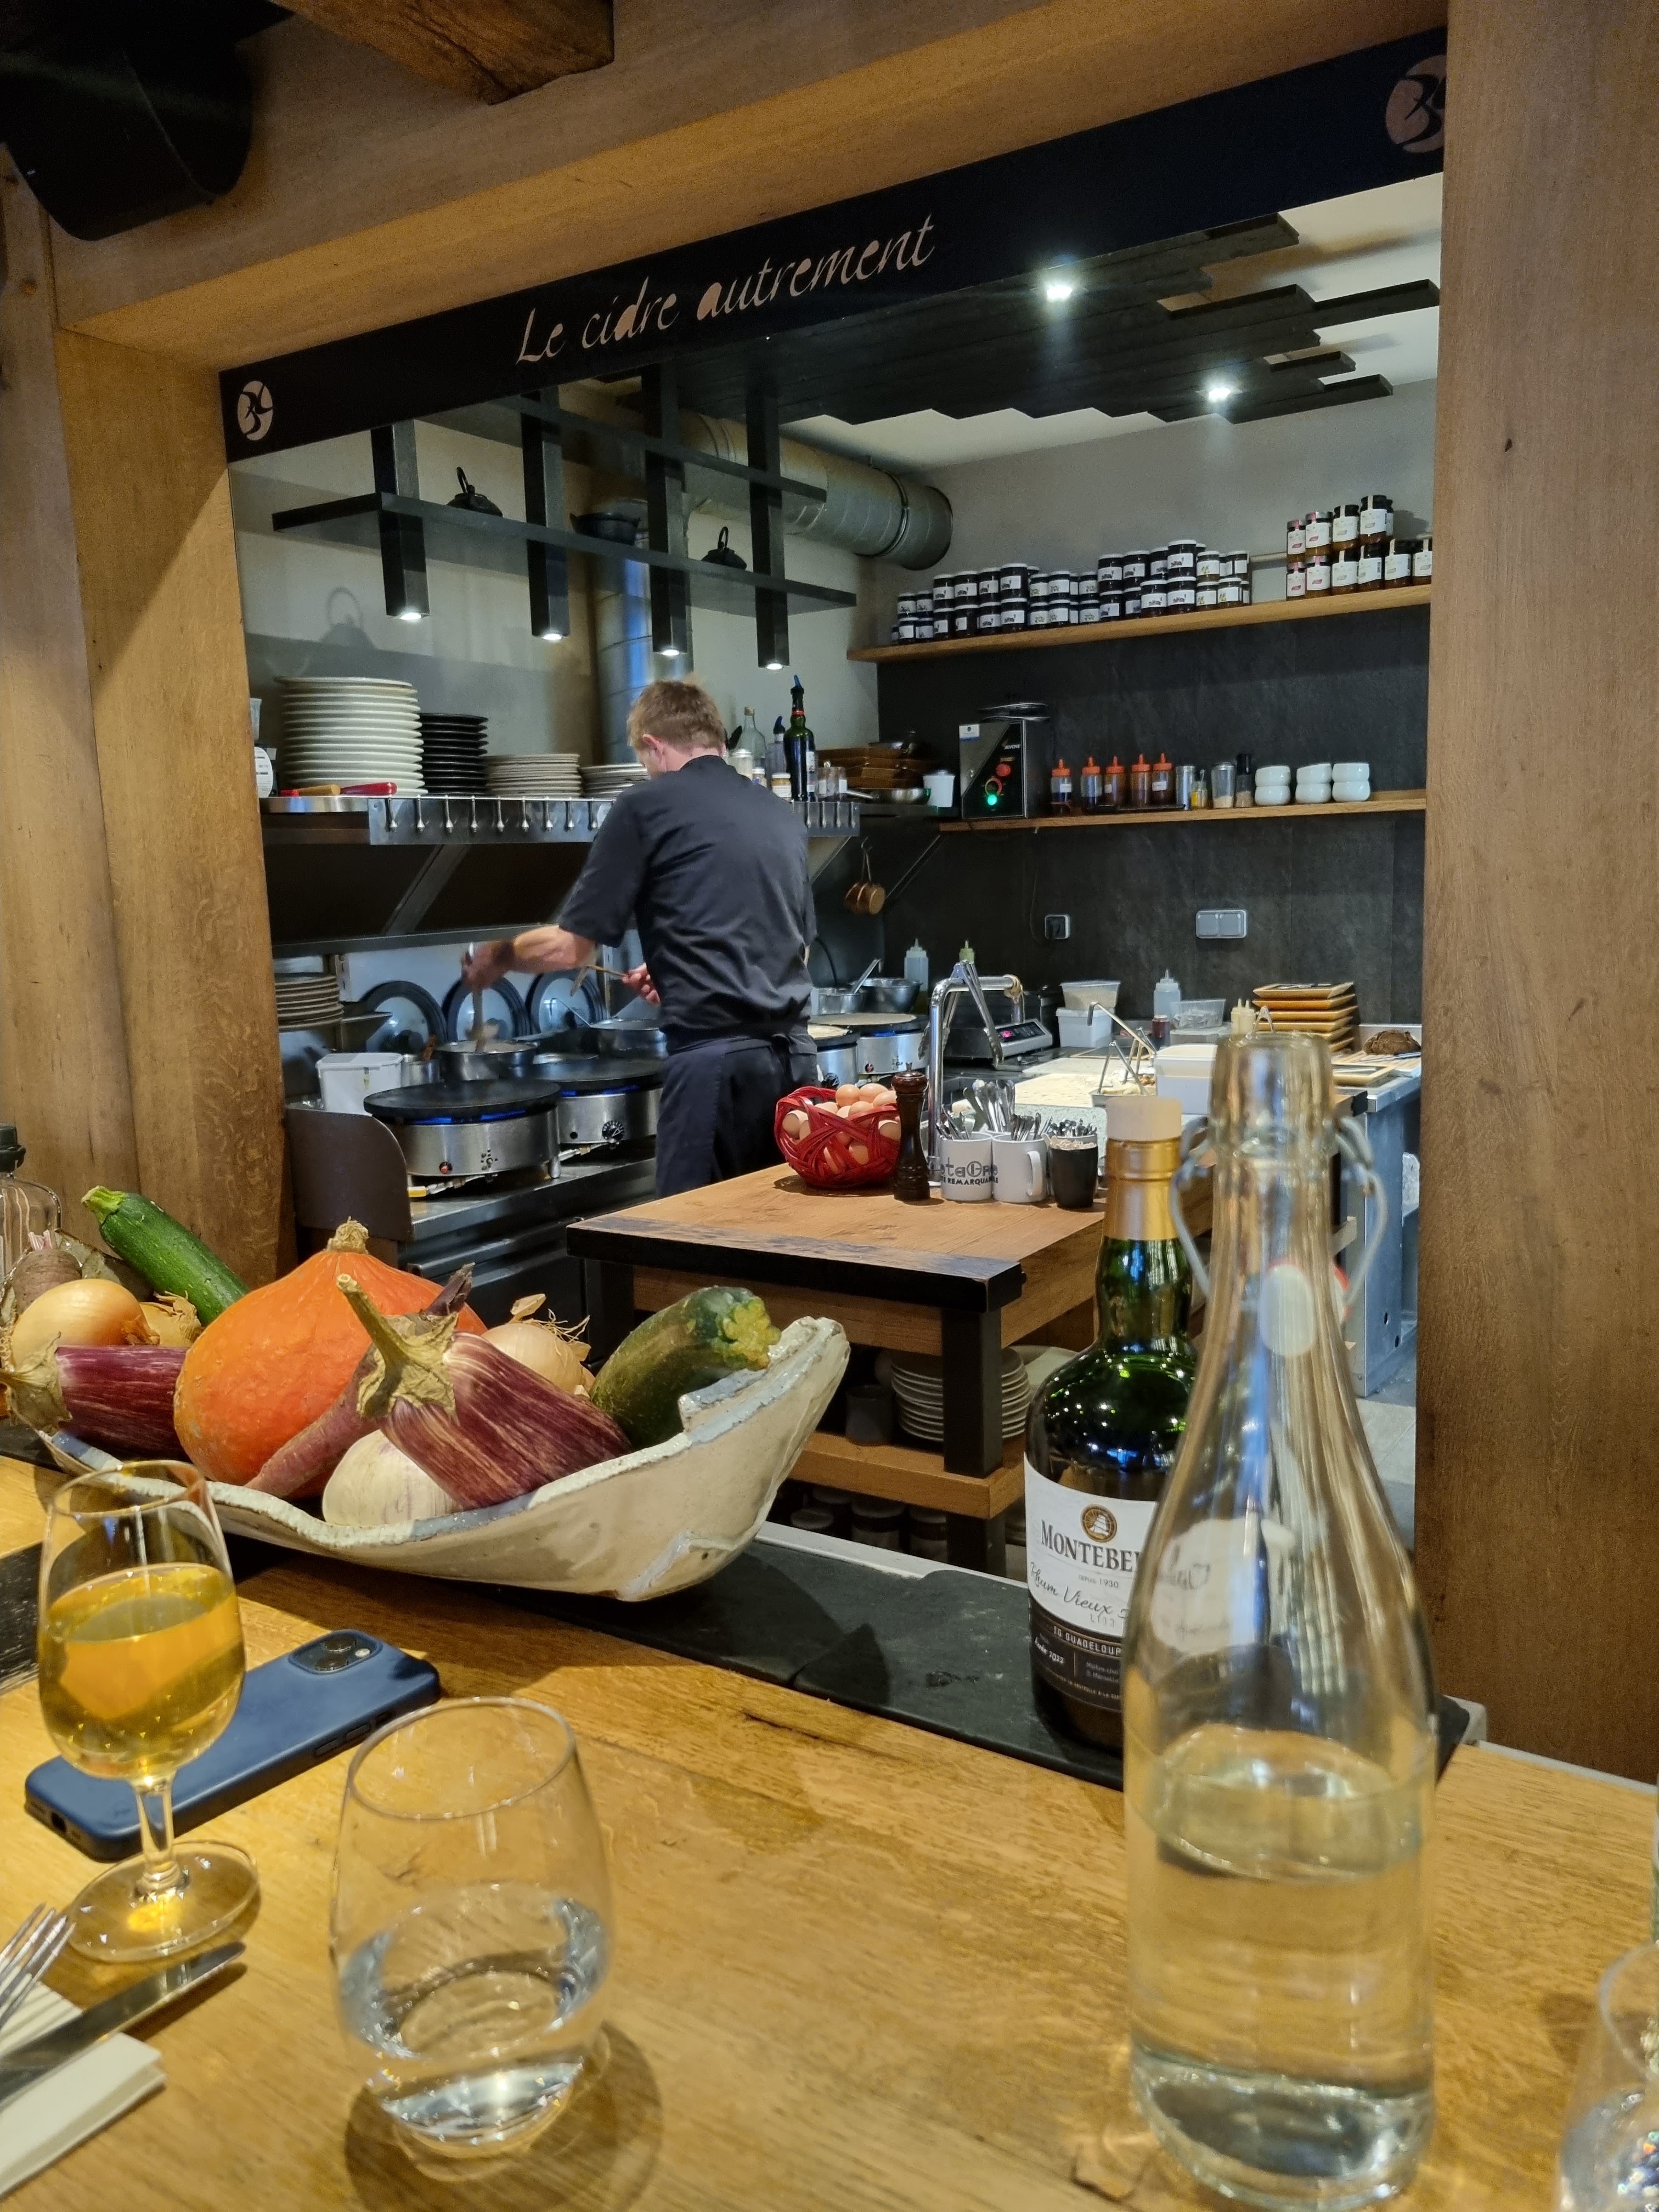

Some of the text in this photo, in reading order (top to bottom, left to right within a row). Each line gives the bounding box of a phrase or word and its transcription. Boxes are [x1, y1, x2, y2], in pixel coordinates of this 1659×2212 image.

[516, 213, 935, 365] Le cidre autrement
[1030, 1561, 1113, 1618] Rhum Vieux
[1099, 1579, 1119, 1588] 1930
[1065, 1632, 1122, 1656] GUADELOUP
